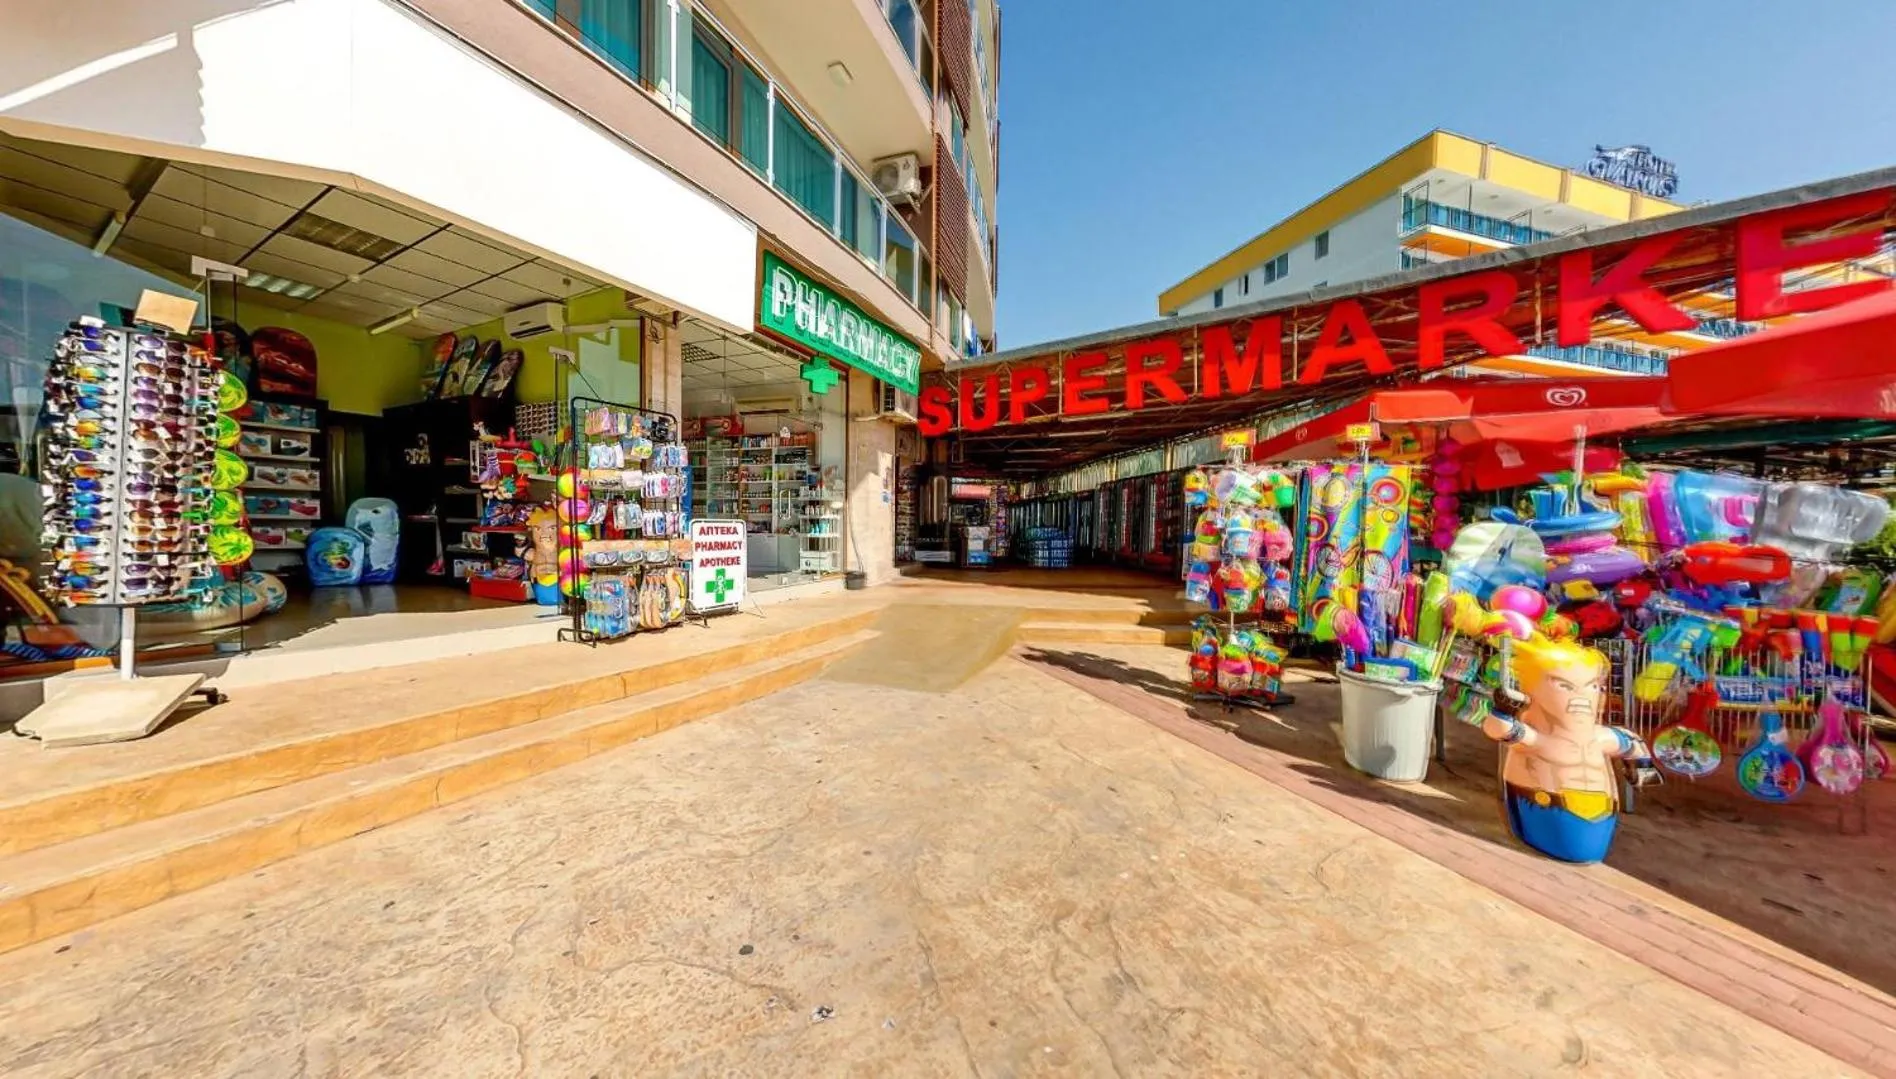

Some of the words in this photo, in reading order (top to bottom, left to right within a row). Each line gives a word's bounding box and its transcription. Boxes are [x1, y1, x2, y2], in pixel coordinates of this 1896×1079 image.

[771, 266, 922, 385] PHARMACY
[699, 526, 739, 536] АПТЕКА
[695, 541, 743, 552] PHARMACY
[699, 556, 741, 568] APOTHEKE
